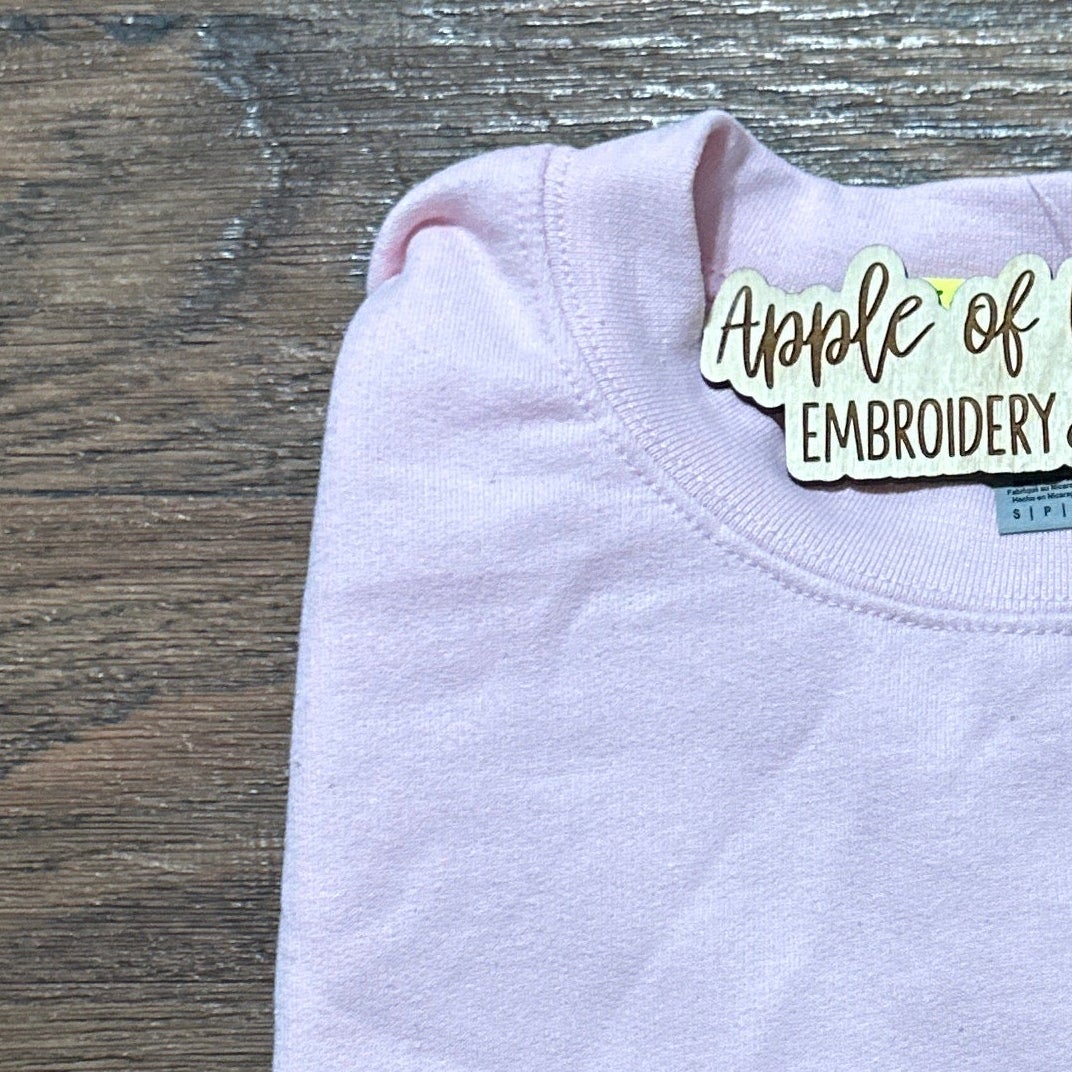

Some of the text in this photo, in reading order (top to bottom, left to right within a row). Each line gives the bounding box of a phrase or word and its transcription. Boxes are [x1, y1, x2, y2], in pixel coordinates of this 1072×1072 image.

[716, 262, 936, 390] Apple
[963, 269, 1040, 378] of
[802, 391, 1057, 463] EMBROIDERY
[1012, 508, 1021, 520] S
[1043, 505, 1052, 517] P
